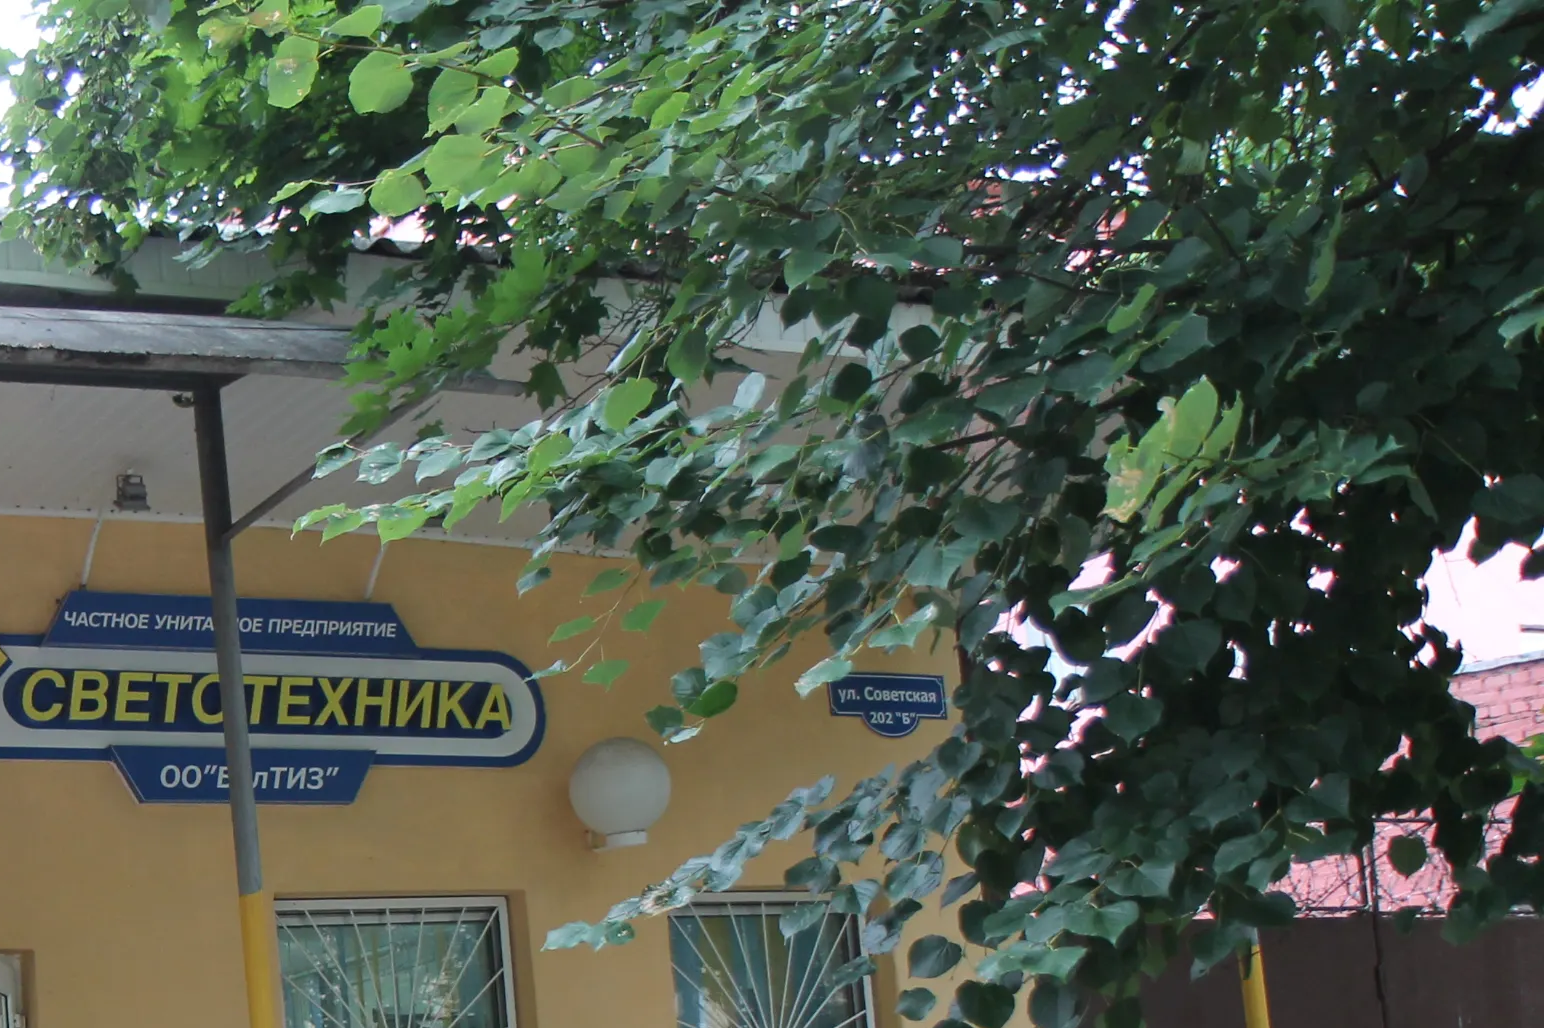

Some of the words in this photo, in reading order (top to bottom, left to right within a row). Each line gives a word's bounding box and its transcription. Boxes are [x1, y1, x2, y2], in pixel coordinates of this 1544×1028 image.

[64, 610, 150, 630] ЧАСТНОЕ
[154, 614, 263, 633] УНИТАОЕ
[267, 618, 397, 638] ПРЕДПРИЯТИЕ
[22, 669, 512, 731] СВЕТОТЕХНИКА
[838, 688, 860, 703] ул.
[864, 686, 937, 703] Советская
[869, 711, 894, 724] 202
